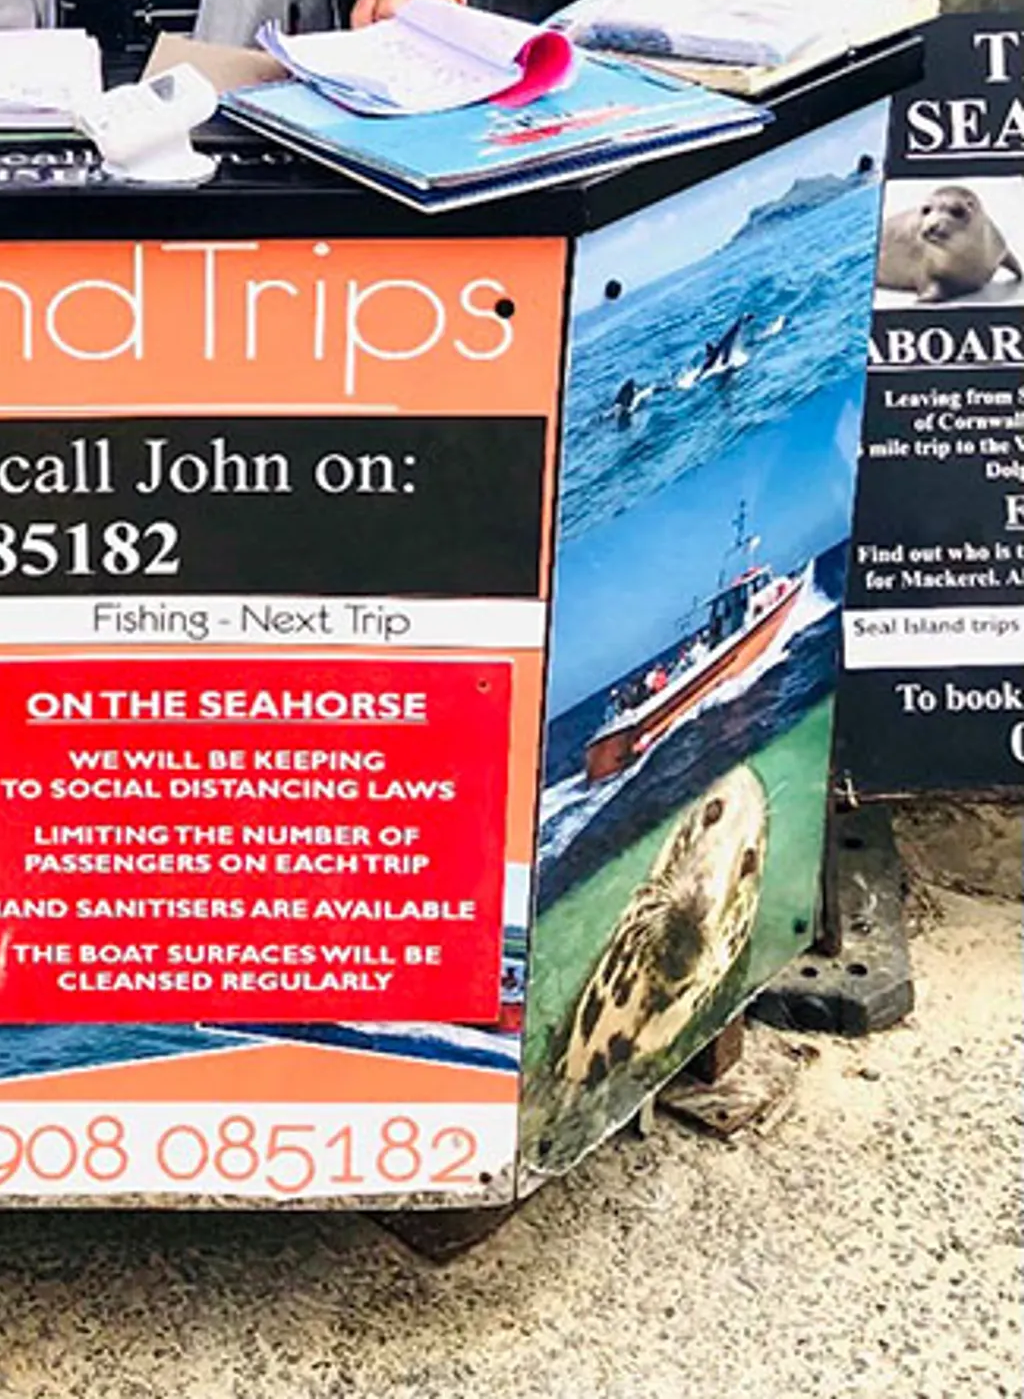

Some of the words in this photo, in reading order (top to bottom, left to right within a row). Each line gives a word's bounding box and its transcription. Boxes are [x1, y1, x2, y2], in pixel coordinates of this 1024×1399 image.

[973, 31, 1024, 83] T
[162, 242, 513, 396] Trips
[885, 389, 962, 411] Leaving
[966, 388, 1013, 405] from
[914, 412, 935, 432] of
[869, 438, 911, 458] mile
[914, 438, 951, 461] trip
[955, 439, 975, 455] to
[980, 437, 1010, 455] the
[135, 438, 292, 494] John
[315, 451, 416, 494] on:
[858, 544, 904, 563] Find
[909, 545, 943, 562] out
[948, 542, 990, 562] who
[995, 542, 1011, 560] is
[866, 570, 895, 590] for
[93, 602, 209, 641] Fishing
[241, 604, 333, 636] Next
[345, 604, 412, 641] Trip
[853, 618, 897, 637] Seal
[904, 617, 965, 635] Island
[971, 617, 1020, 637] trips
[27, 691, 92, 719] ON
[98, 691, 186, 719] THE
[198, 691, 428, 720] SEAHORSE
[895, 682, 937, 712] To
[945, 680, 1024, 711] book
[69, 750, 119, 771] WE
[124, 750, 201, 771] WILL
[209, 750, 246, 771] BE
[254, 750, 386, 771] KEEPING
[0, 779, 44, 800] TO
[50, 779, 159, 800] SOCIAL
[169, 778, 359, 800] DISTANCING
[368, 779, 456, 800] LAWS
[34, 825, 170, 847] LIMITING
[174, 825, 234, 847] THE
[242, 825, 370, 847] NUMBER
[379, 825, 421, 847] OF
[24, 853, 212, 874] PASSENGERS
[220, 854, 267, 874] ON
[276, 854, 359, 874] EACH
[362, 853, 431, 874] TRIP
[76, 899, 250, 920] SANITISERS
[251, 899, 308, 920] ARE
[312, 899, 477, 921] AVAILABLE
[12, 945, 72, 965] THE
[79, 945, 159, 965] BOAT
[168, 944, 316, 965] SURFACES
[319, 944, 396, 965] WILL
[405, 944, 442, 964] BE
[57, 972, 213, 992] CLEANSED
[222, 972, 394, 992] REGULARLY
[156, 1114, 478, 1193] 085182
